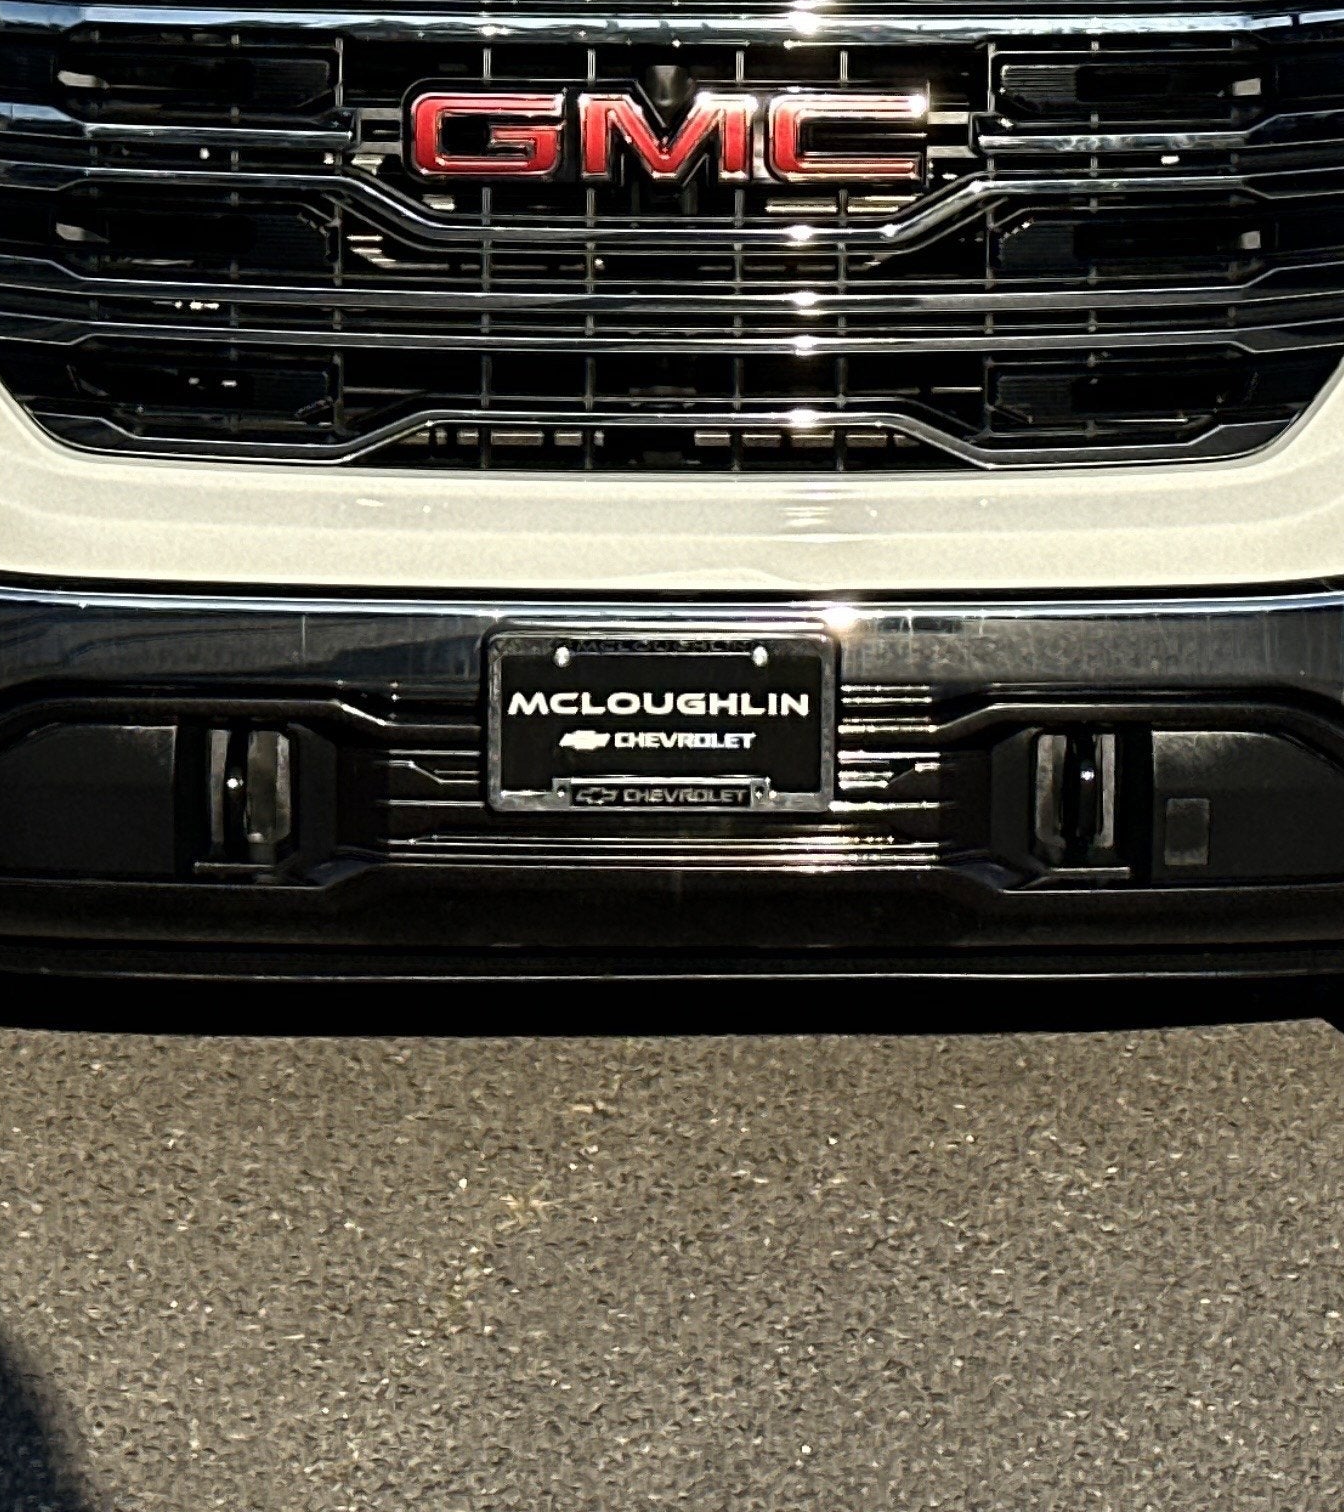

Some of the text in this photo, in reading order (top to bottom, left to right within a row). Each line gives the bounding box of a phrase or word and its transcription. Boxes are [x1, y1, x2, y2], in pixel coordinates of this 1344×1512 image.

[410, 91, 928, 183] GMC
[507, 691, 809, 716] MCLOUGHLIN
[614, 731, 757, 749] CHEVROLET
[623, 788, 747, 804] CHEVROLET
